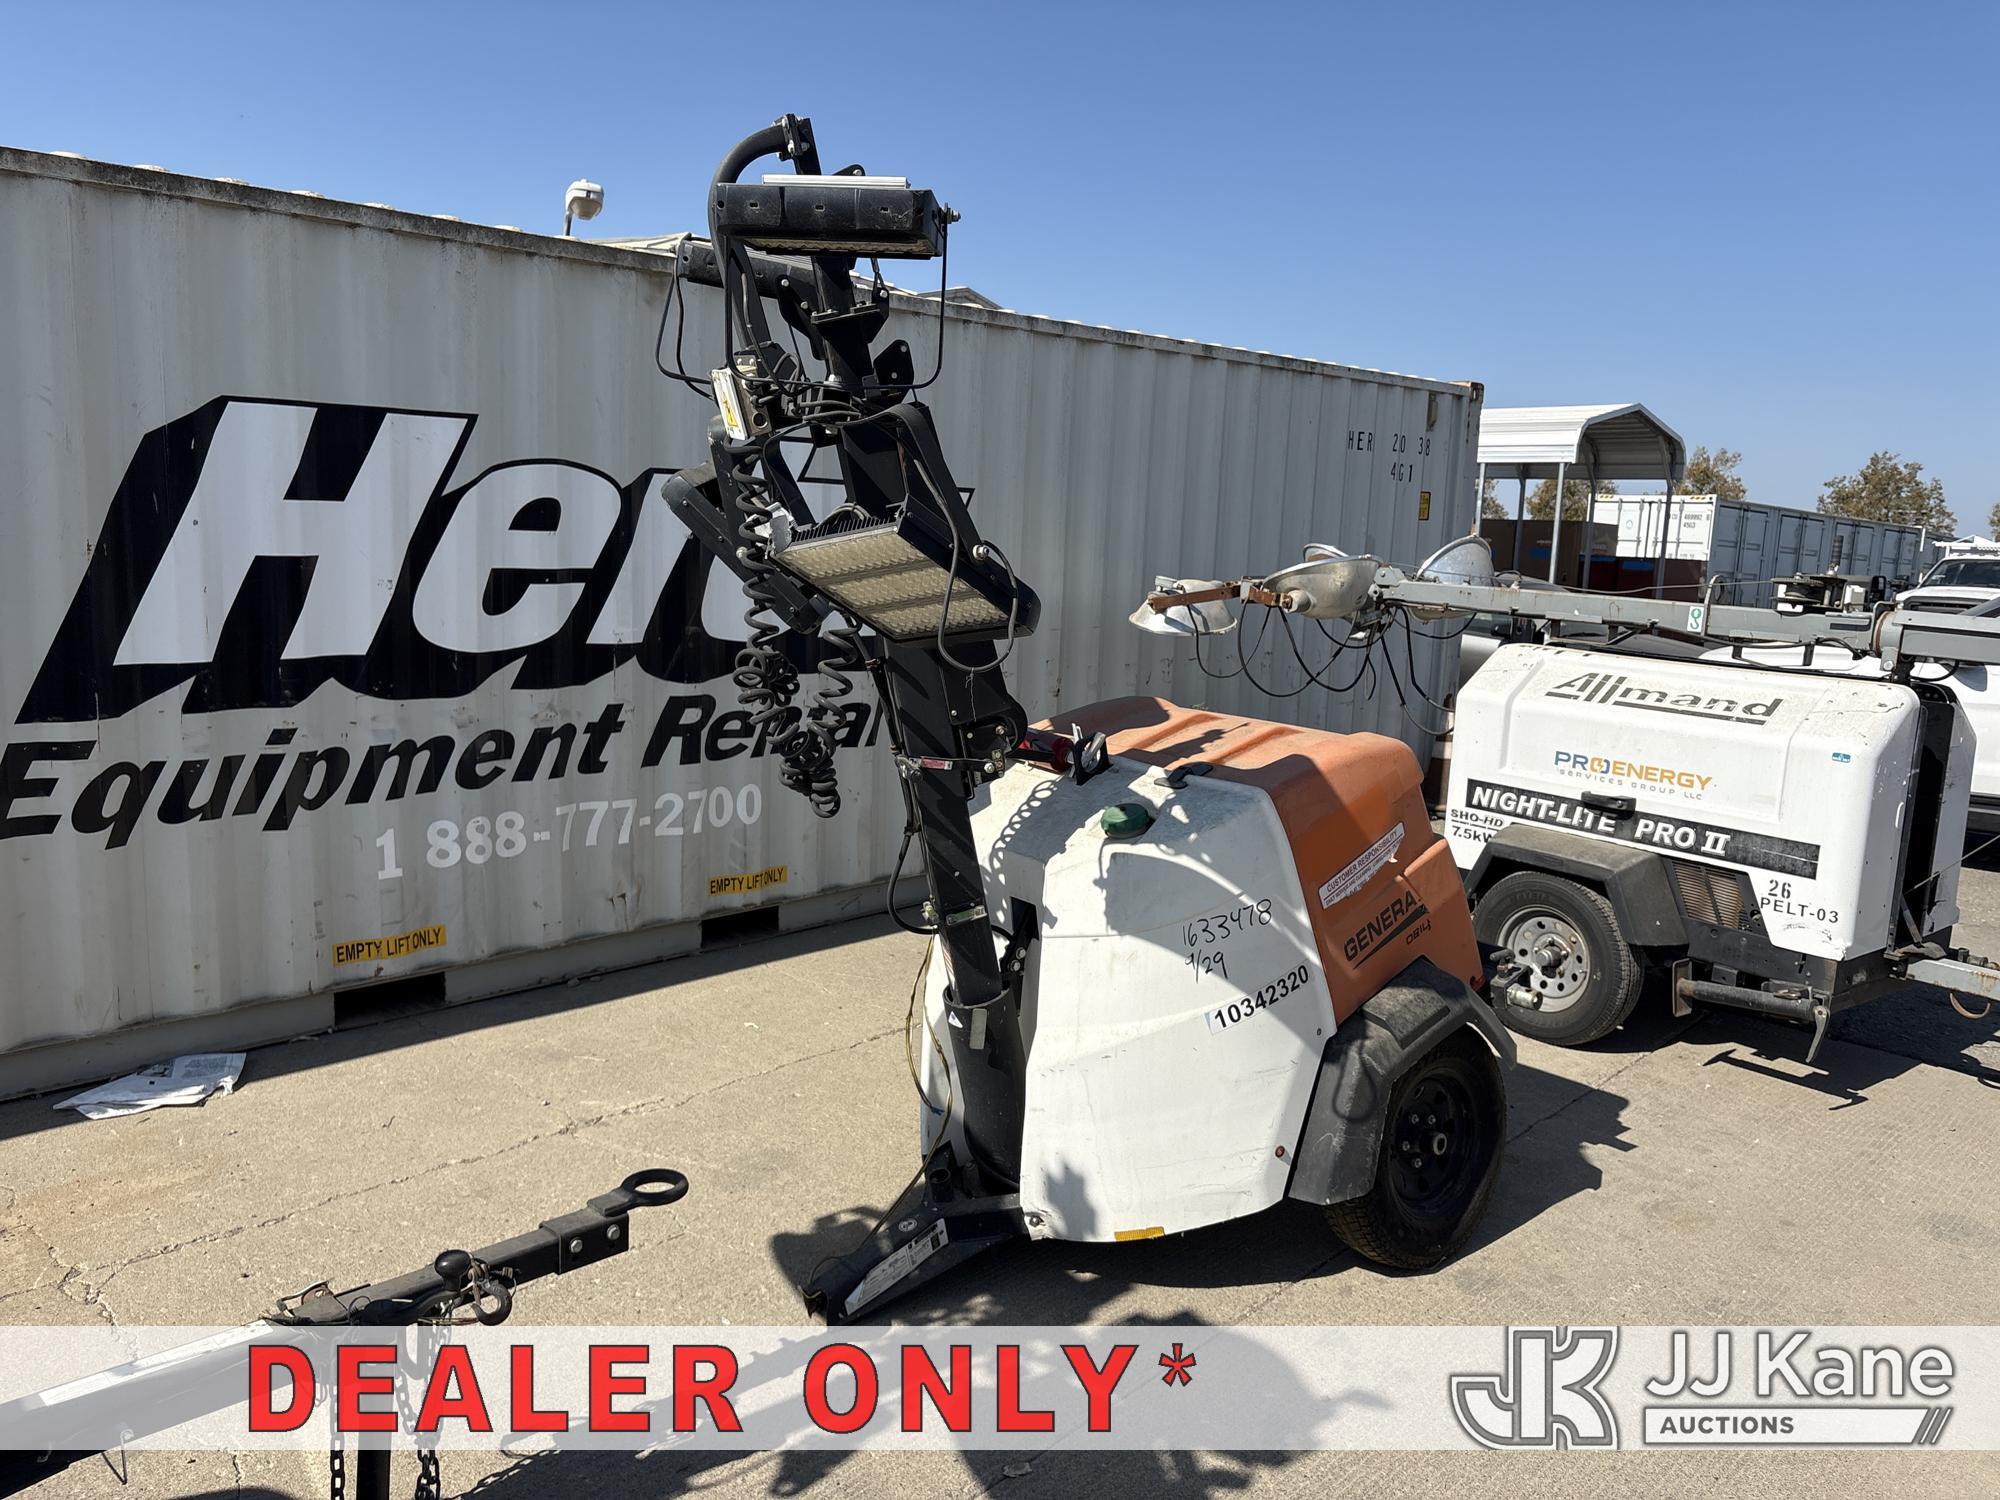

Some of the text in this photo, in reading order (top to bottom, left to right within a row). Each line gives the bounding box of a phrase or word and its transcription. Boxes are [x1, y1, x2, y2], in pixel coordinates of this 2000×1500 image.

[1348, 430, 1431, 456] HER 20 38
[1547, 672, 1784, 721] Allmand
[0, 703, 624, 850] Equipment
[1554, 751, 1714, 790] PROENERGY
[1559, 769, 1703, 801] SERVICES GROUP LLC
[375, 783, 762, 880] 1 888-777-2700
[1450, 809, 1504, 828] SHO-HD
[1471, 786, 1732, 856] NIGHT-LITE PRO II
[710, 867, 784, 895] EMPTY LIFT ONLY
[1326, 864, 1358, 893] CUSTOMER
[1358, 831, 1398, 868] RESPONSIBILITY
[1768, 879, 1791, 899] 26
[1183, 899, 1271, 947] 1633478
[1760, 897, 1839, 923] PELT-03
[336, 928, 442, 963] EMPTY LIFT ONLY
[1214, 965, 1309, 1028] 10342320
